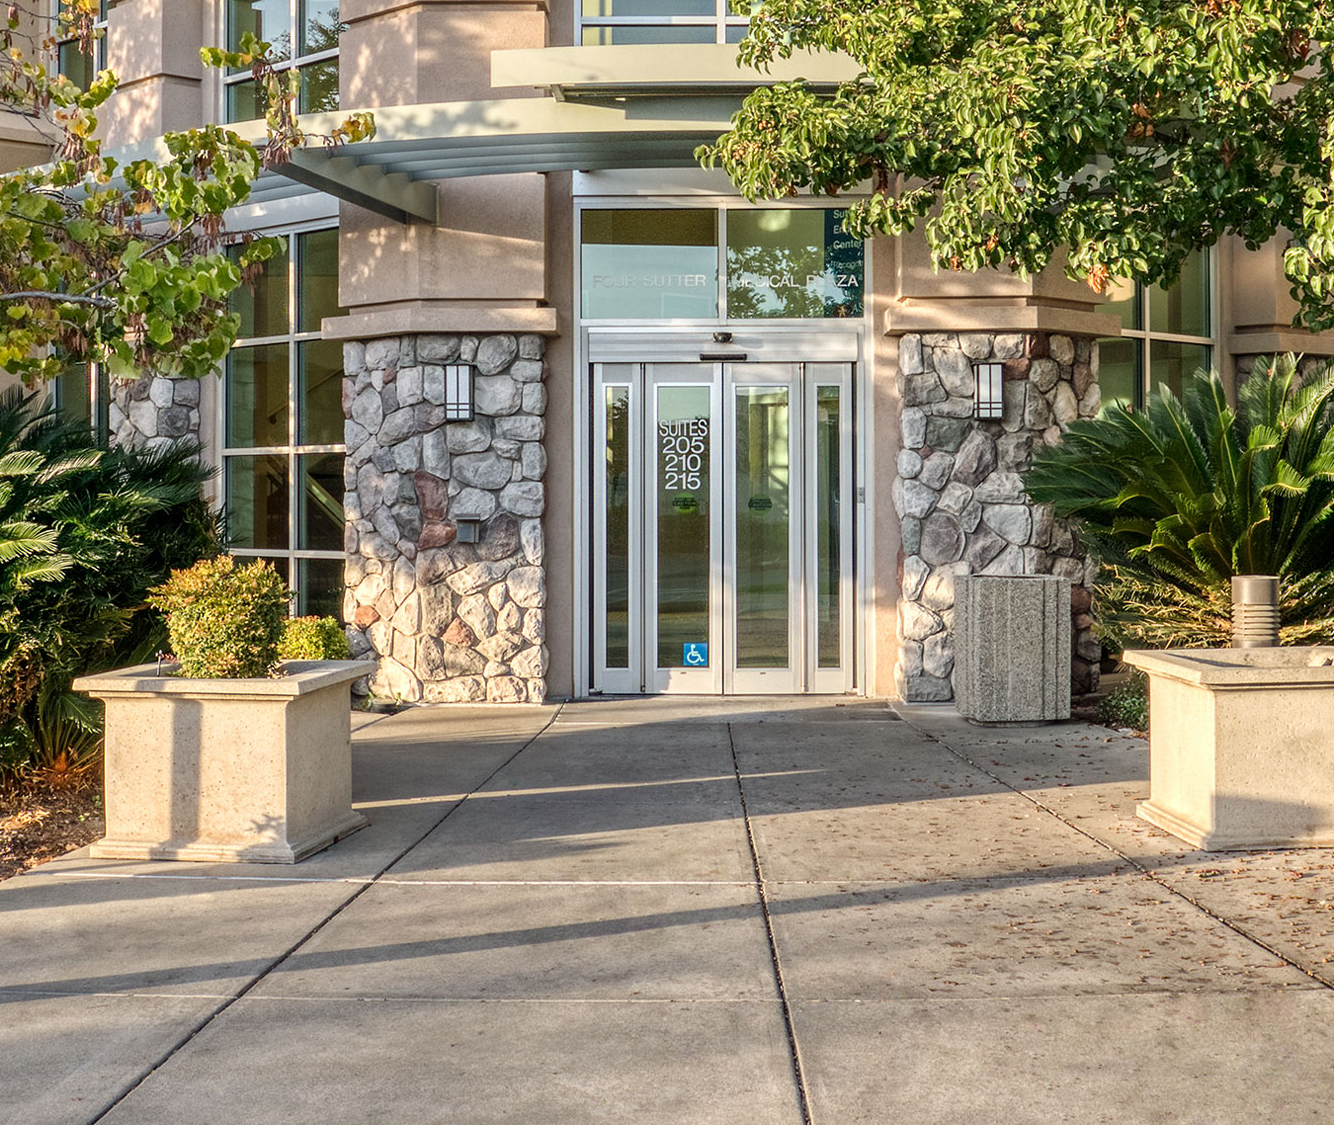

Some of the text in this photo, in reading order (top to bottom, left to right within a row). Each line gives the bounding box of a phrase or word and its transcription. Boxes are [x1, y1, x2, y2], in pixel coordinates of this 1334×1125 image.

[592, 275, 635, 288] FOUR
[643, 274, 706, 288] SUTTER
[735, 274, 800, 288] MEDICAL
[658, 419, 708, 437] SUITES
[662, 436, 705, 454] 205
[664, 454, 701, 472] 210
[664, 472, 701, 490] 215
